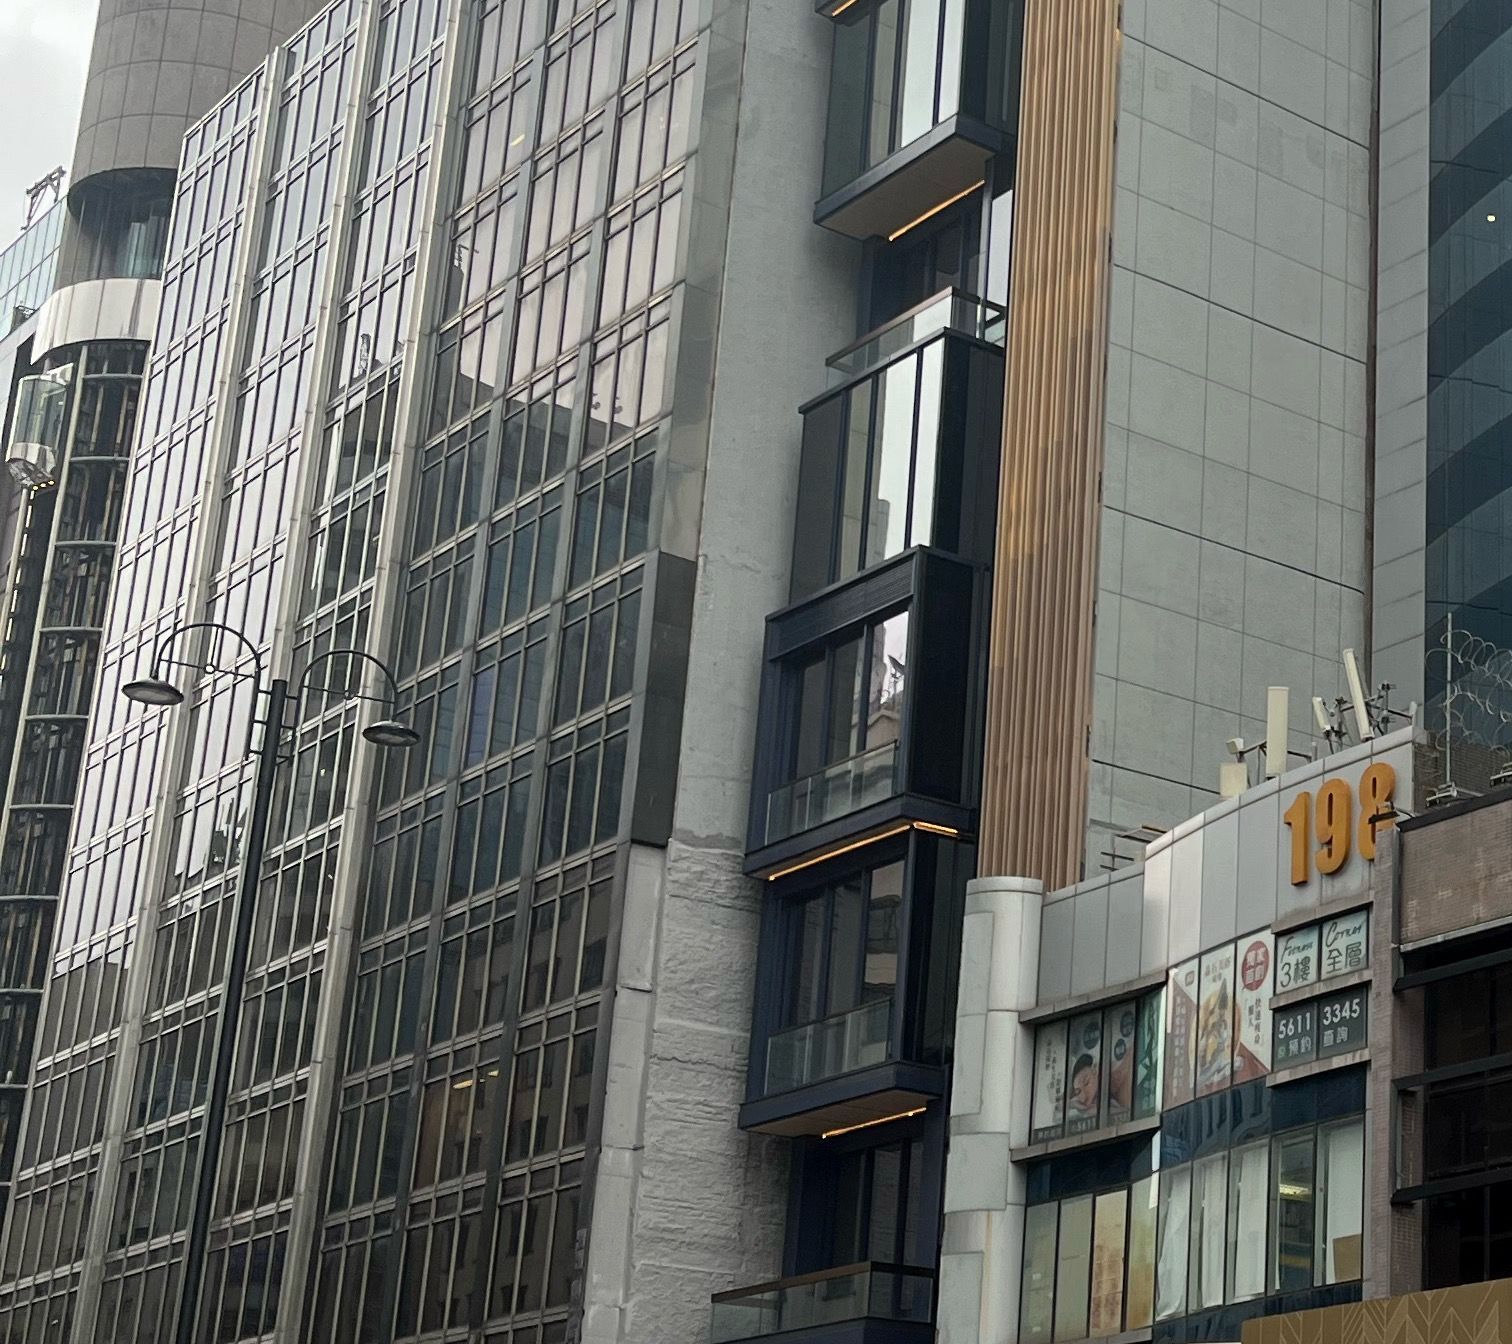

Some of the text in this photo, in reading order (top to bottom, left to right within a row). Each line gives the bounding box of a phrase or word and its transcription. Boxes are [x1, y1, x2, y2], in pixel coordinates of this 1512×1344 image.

[1284, 762, 1396, 886] 198
[1278, 998, 1361, 1039] 5611 3345
